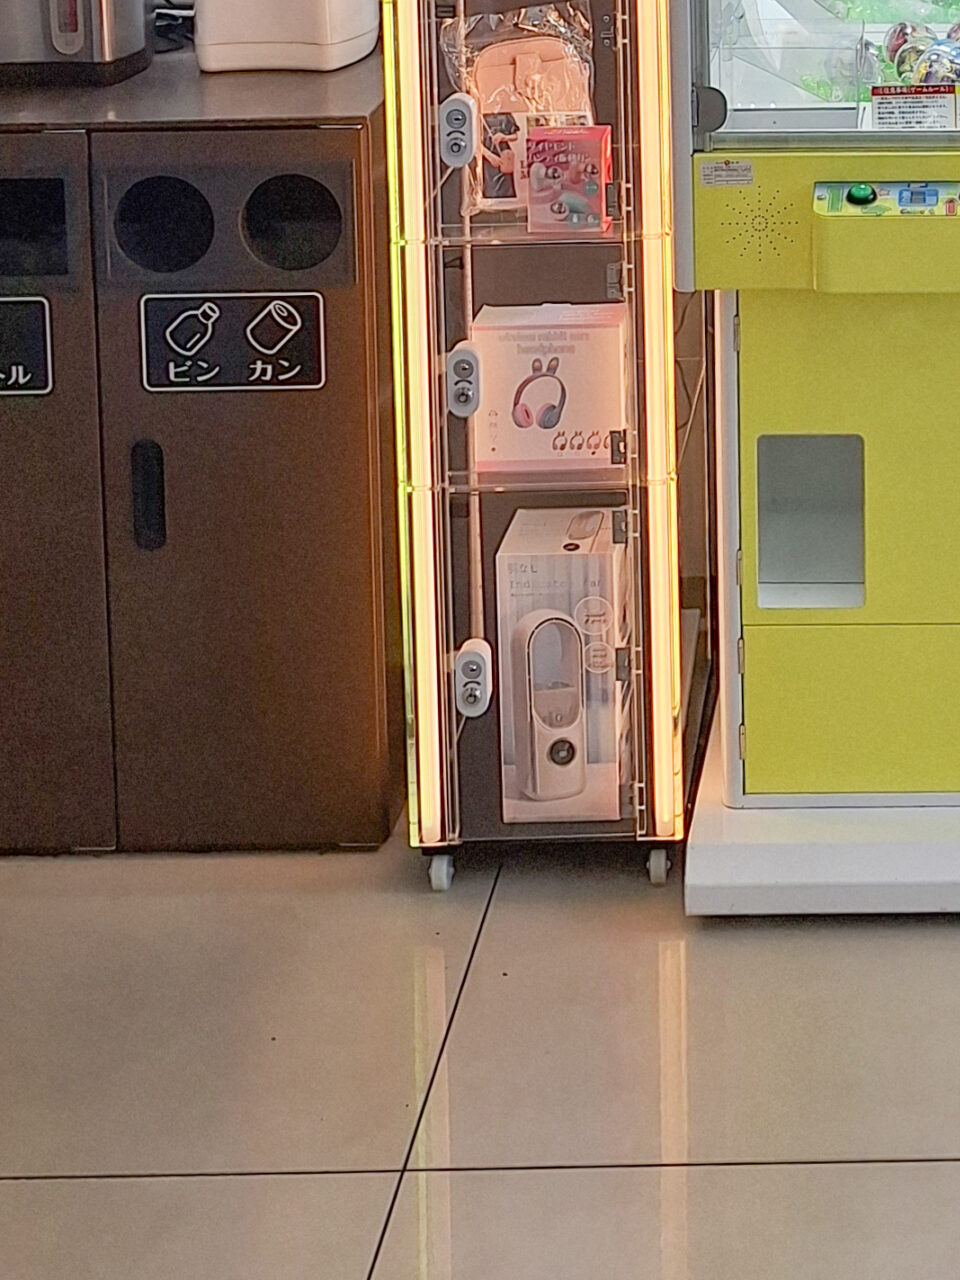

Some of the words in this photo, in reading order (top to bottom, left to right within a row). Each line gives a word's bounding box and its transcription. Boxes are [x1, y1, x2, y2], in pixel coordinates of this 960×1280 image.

[0, 365, 32, 386] ル
[168, 360, 220, 383] ビン
[248, 360, 302, 382] カン
